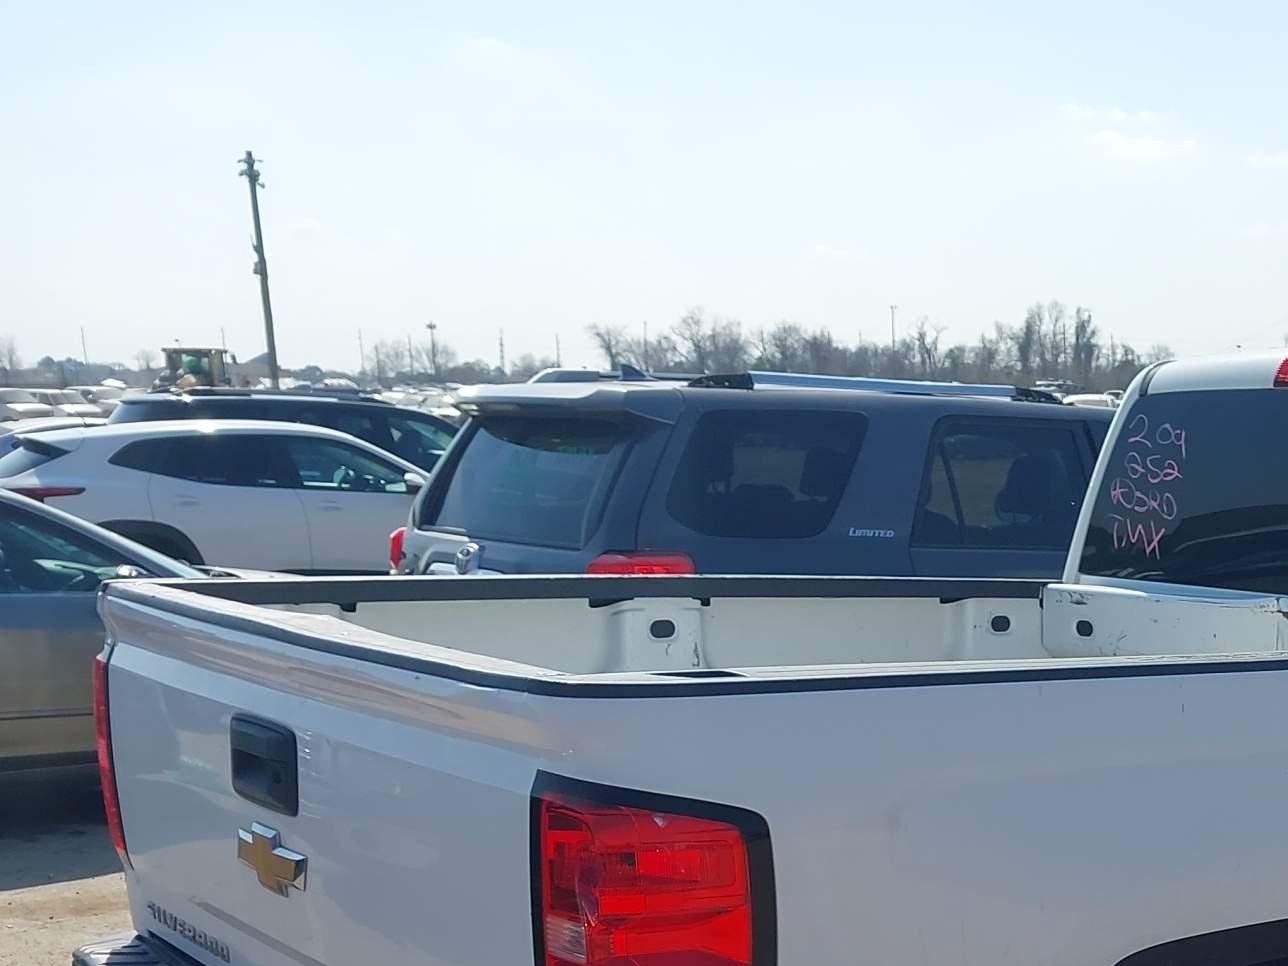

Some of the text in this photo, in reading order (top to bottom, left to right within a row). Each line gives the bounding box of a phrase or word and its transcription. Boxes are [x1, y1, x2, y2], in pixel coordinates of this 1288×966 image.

[1128, 414, 1186, 458] 209
[1126, 452, 1183, 483] 252
[147, 901, 231, 963] SILVERADO
